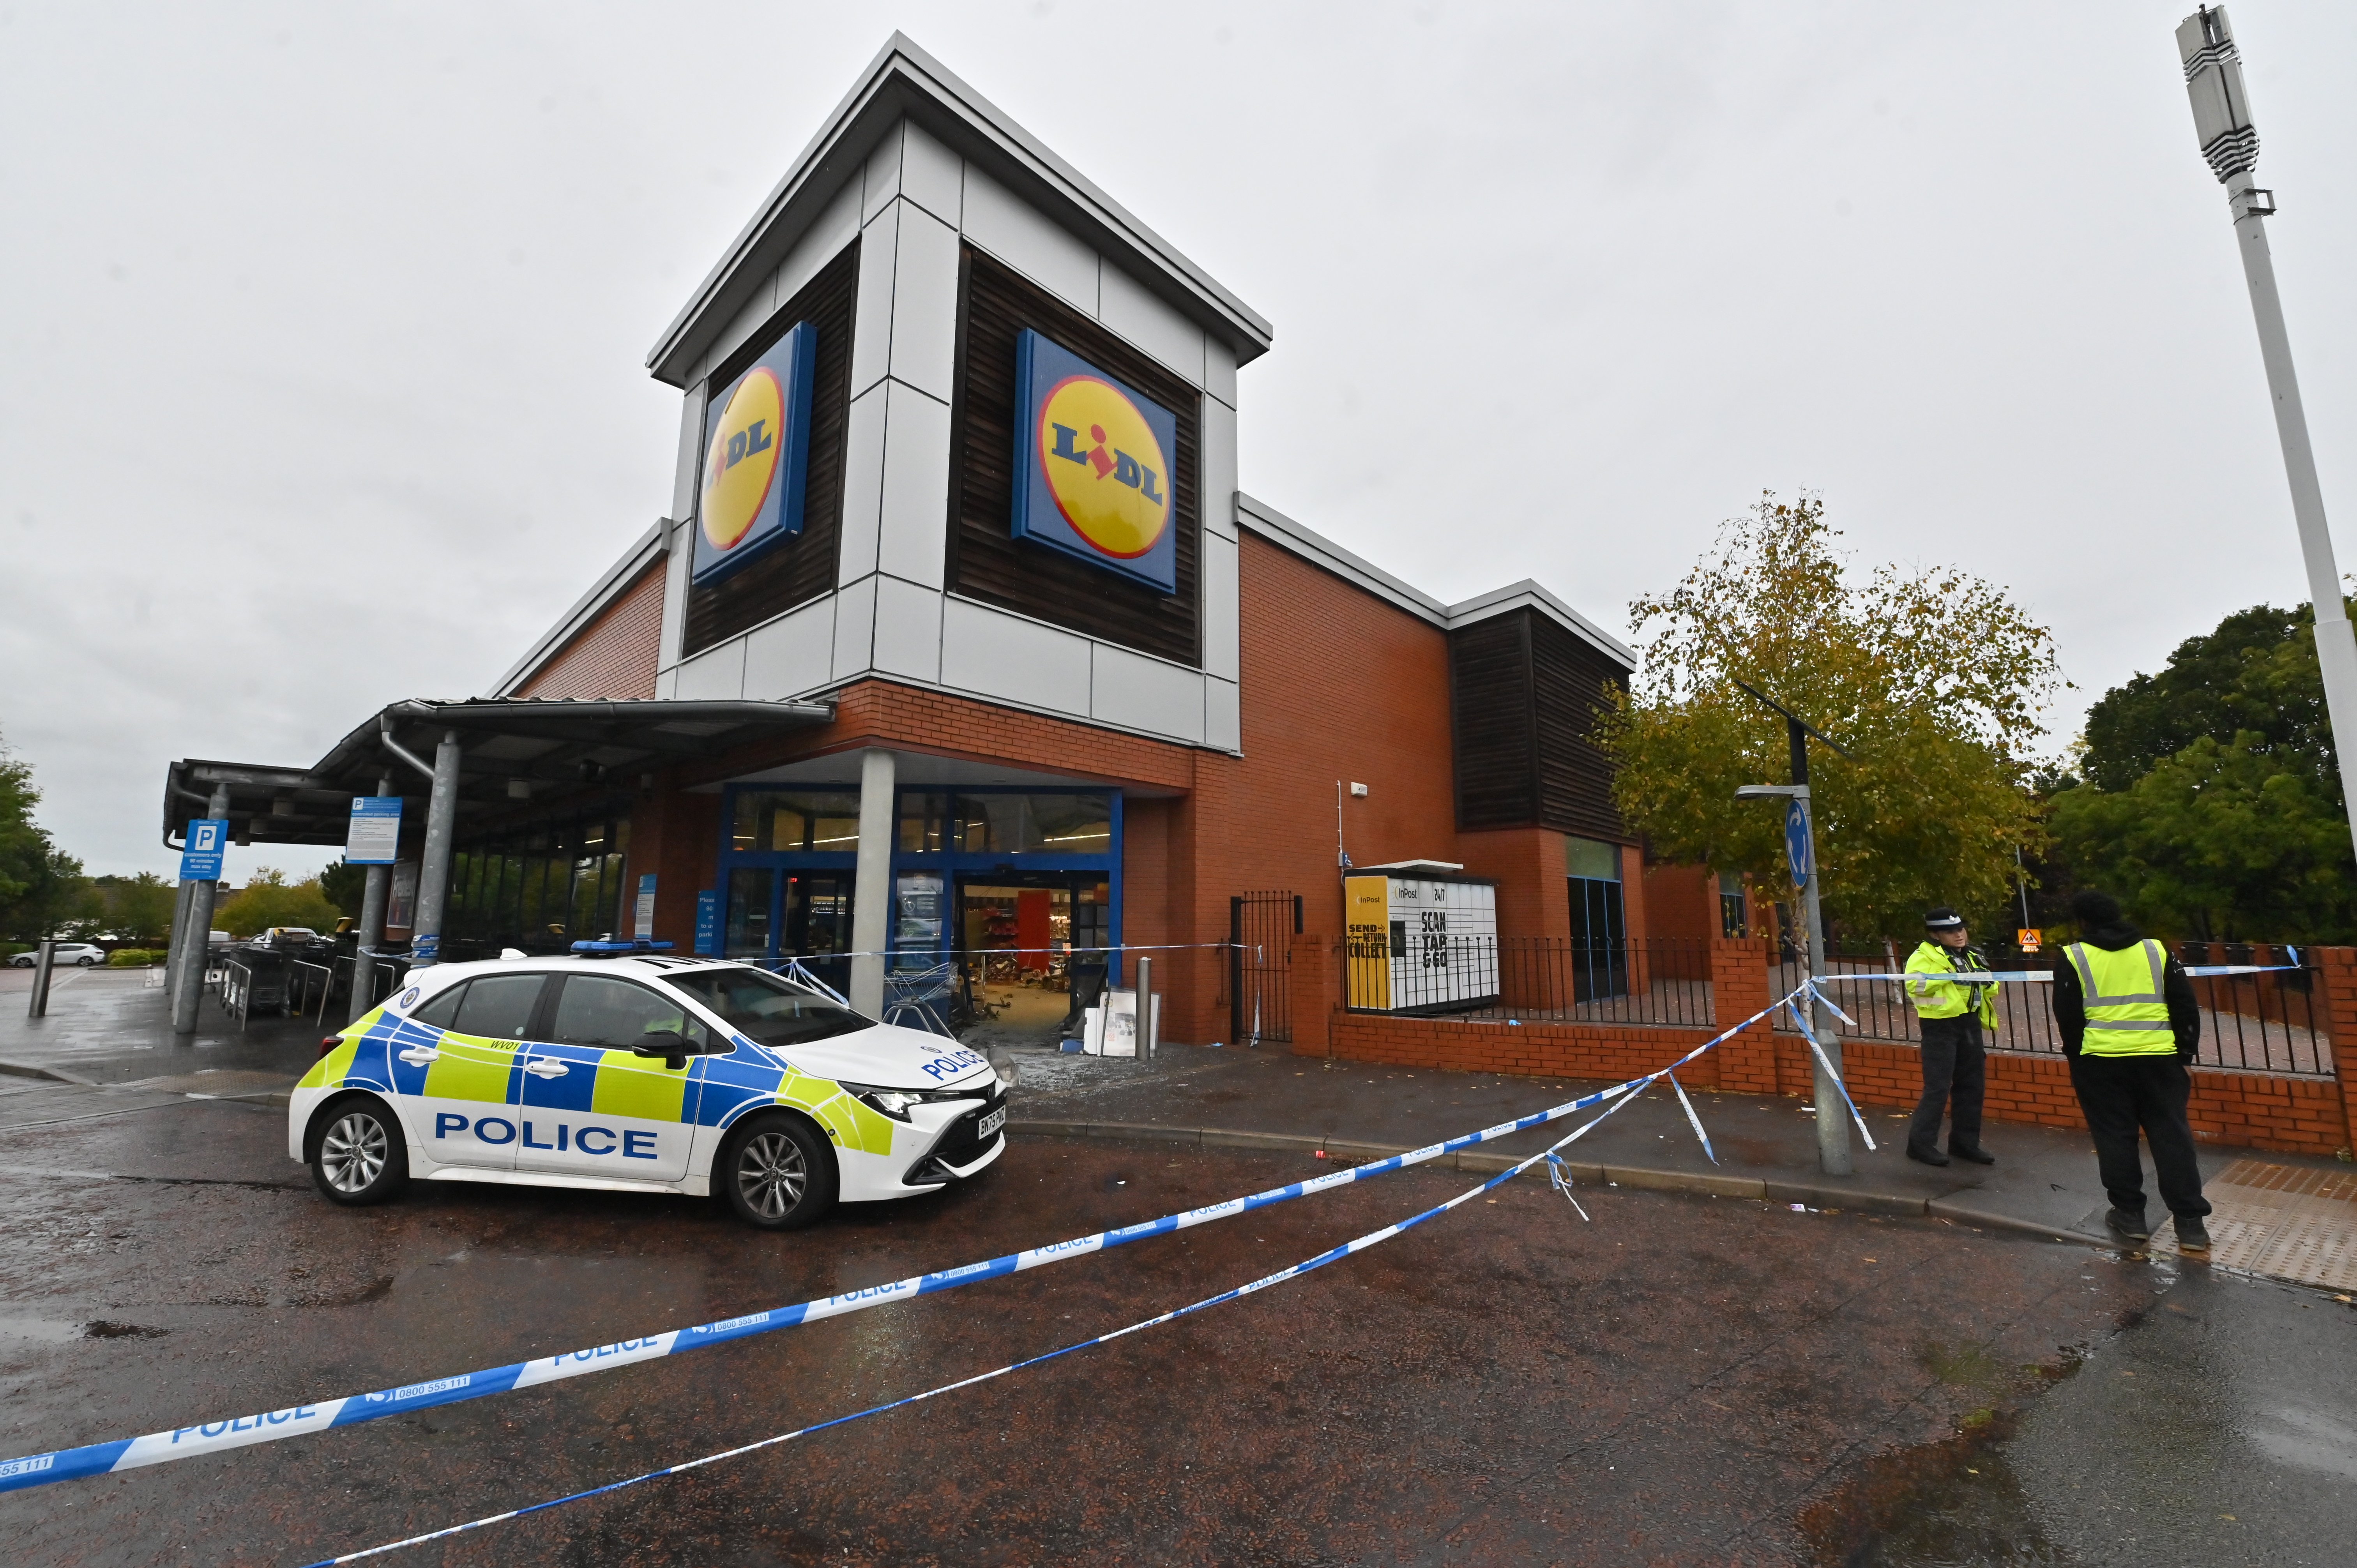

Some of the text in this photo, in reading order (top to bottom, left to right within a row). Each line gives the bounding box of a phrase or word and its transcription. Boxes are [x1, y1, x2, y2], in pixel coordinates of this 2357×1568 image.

[355, 800, 362, 808] P
[200, 830, 213, 847] P
[1399, 888, 1417, 899] InPost
[1434, 888, 1445, 902] 24/7
[1349, 924, 1377, 932] SEND
[1422, 911, 1446, 932] SCAN
[1422, 933, 1446, 951] TAP
[491, 1040, 520, 1050] WV01
[921, 1051, 985, 1081] POLICE
[981, 1107, 1005, 1135] BN75 PNZ
[436, 1113, 657, 1160] POLICE
[951, 1268, 965, 1277] 0800
[717, 1314, 767, 1330] 0800 555 111
[399, 1377, 466, 1398] 0800 555 111
[26, 1458, 49, 1471] 111
